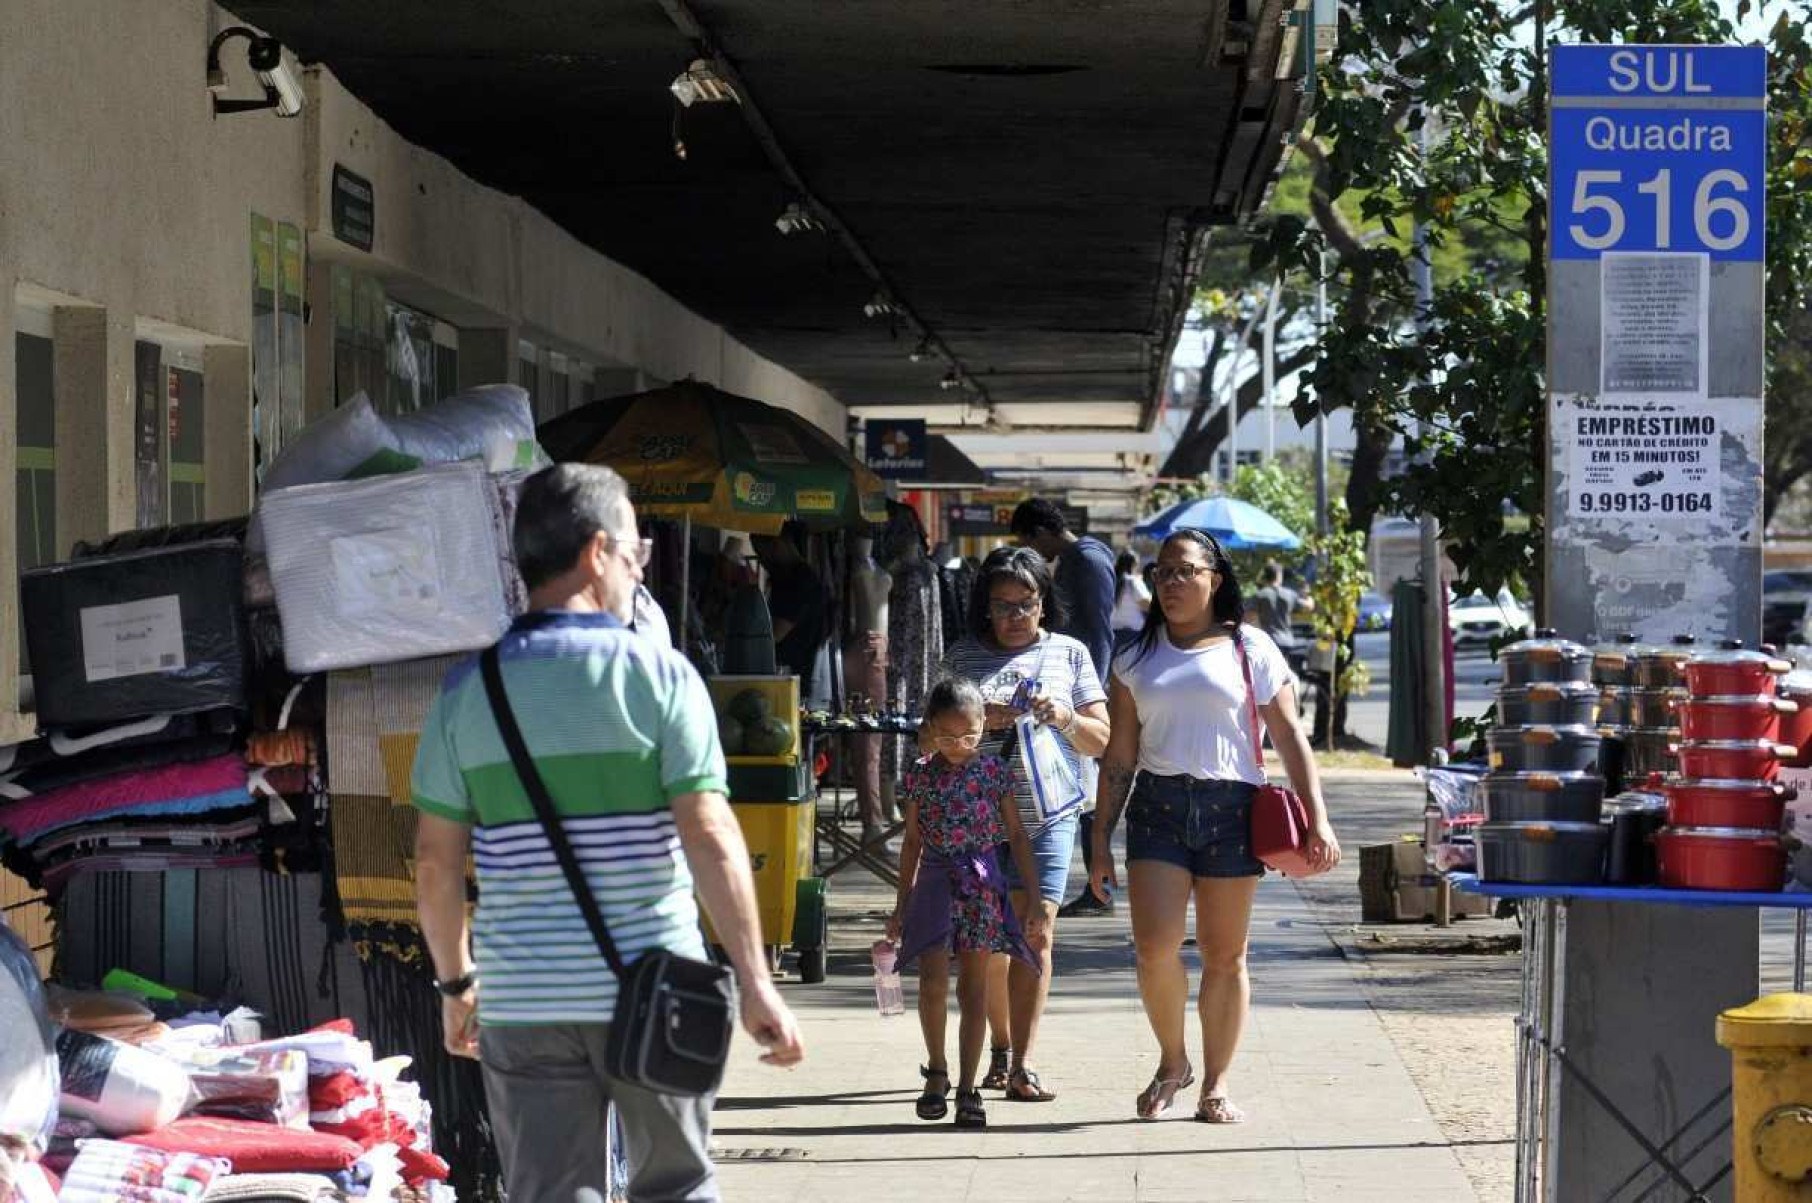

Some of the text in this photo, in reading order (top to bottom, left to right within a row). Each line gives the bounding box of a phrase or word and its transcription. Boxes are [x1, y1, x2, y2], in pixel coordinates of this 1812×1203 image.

[1608, 51, 1711, 92] SUL
[1585, 117, 1732, 150] Quadra
[1569, 169, 1750, 250] 516
[1578, 414, 1715, 436] EMPRÉSTIMO
[1578, 437, 1709, 447] NO CARTÃO DE CRÉDITO
[1592, 451, 1700, 462] EM 15 MINUTOS!
[1580, 492, 1712, 512] 9.9913-0164
